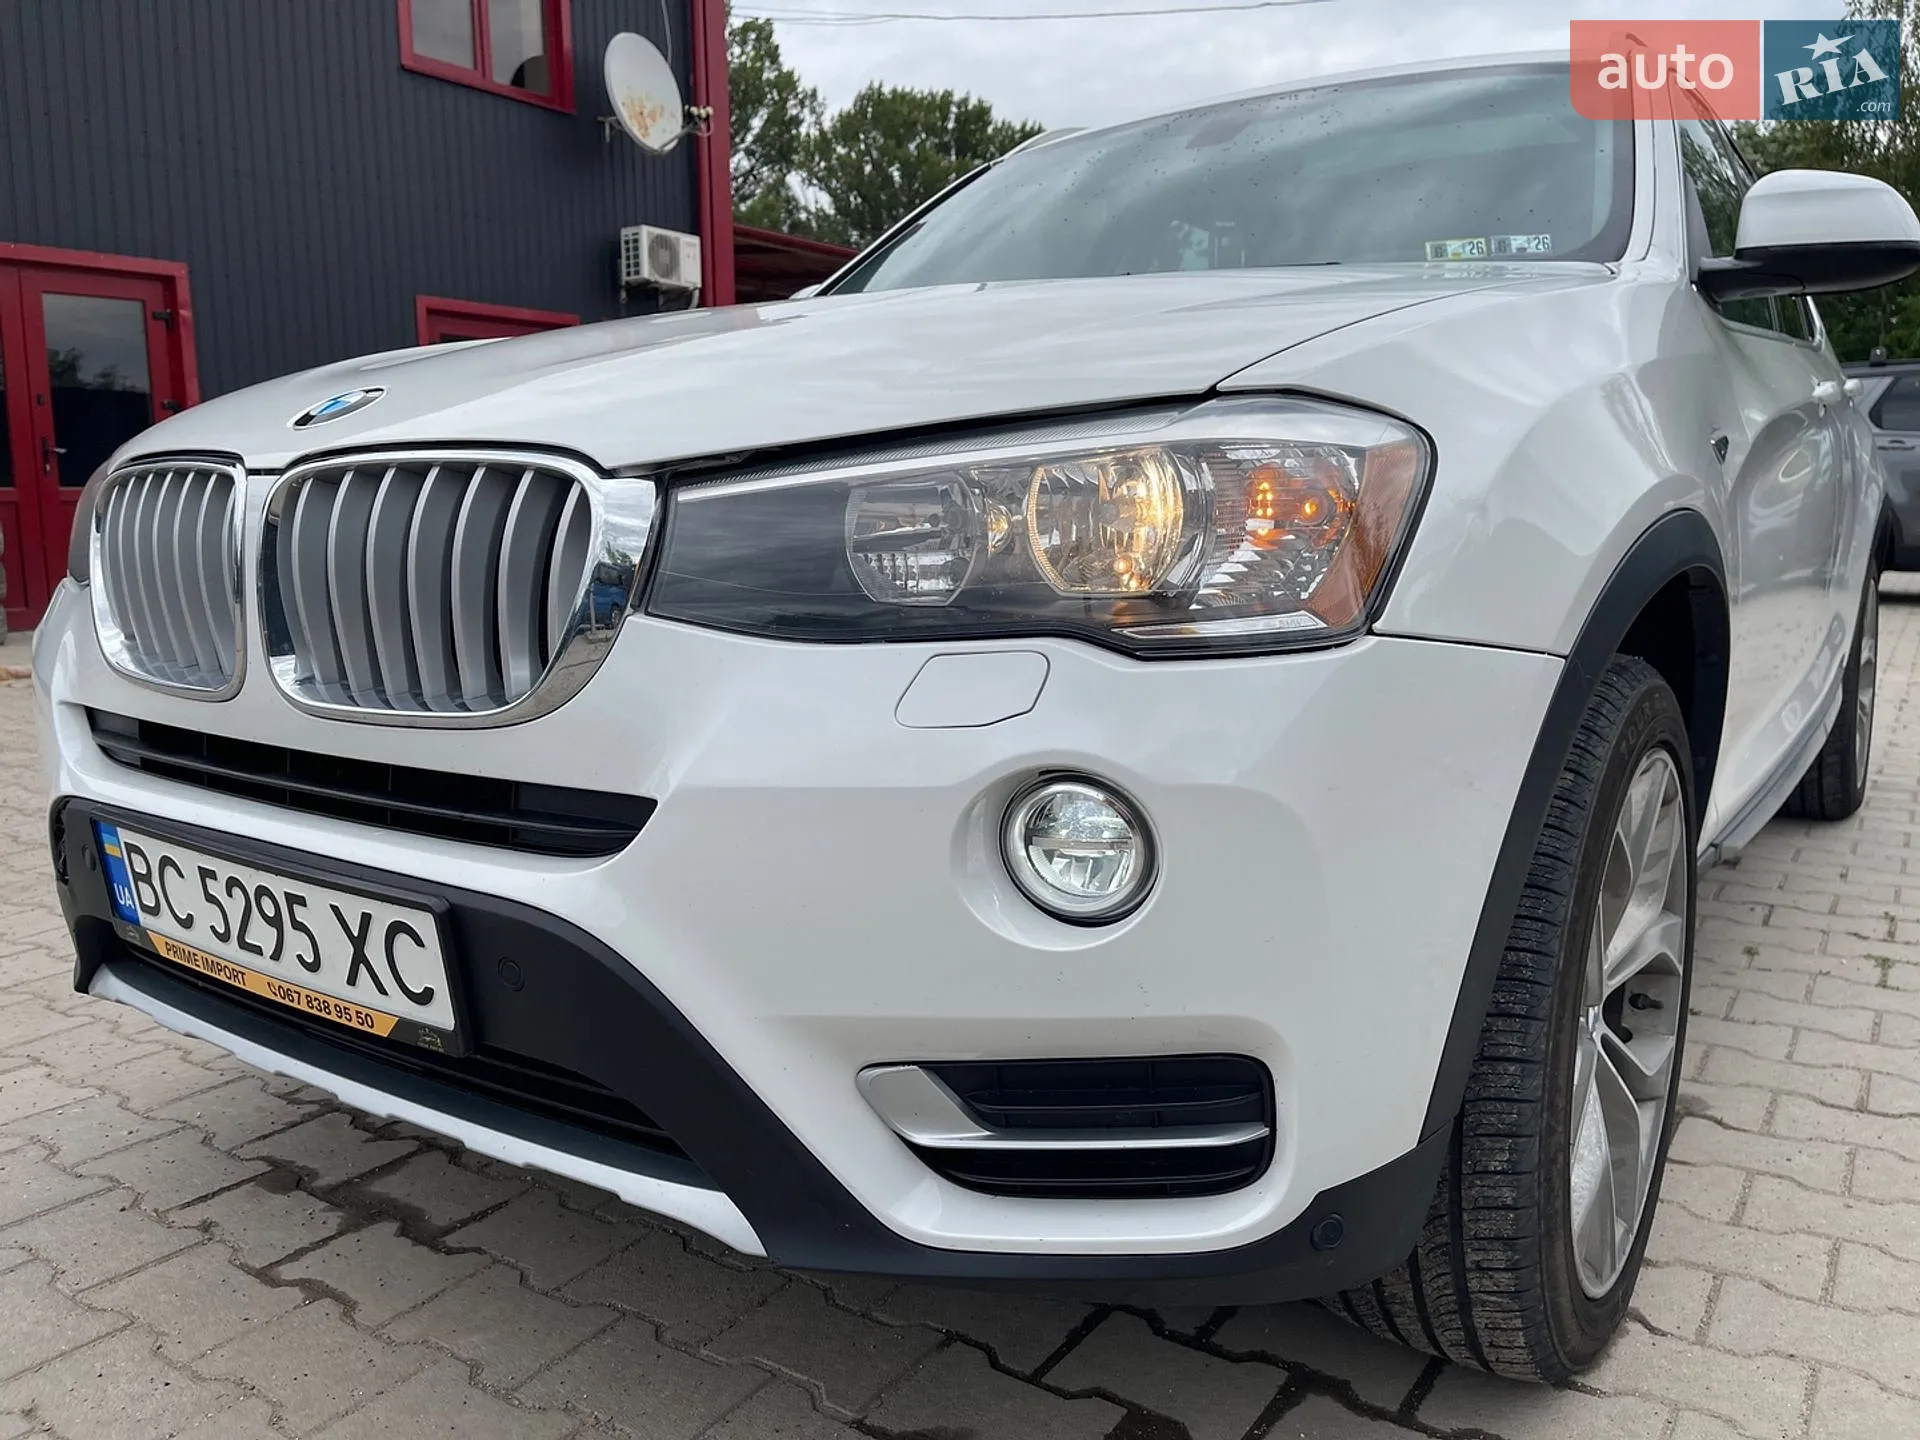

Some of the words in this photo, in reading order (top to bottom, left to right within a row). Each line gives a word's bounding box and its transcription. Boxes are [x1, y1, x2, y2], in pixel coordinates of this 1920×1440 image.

[1467, 241, 1485, 256] 26
[1534, 235, 1550, 251] 26
[115, 882, 135, 910] UA
[123, 840, 195, 930] BC
[197, 865, 322, 974] 5295
[328, 902, 436, 1006] XC
[165, 941, 200, 968] PRIME
[200, 955, 247, 986] IMPORT
[278, 984, 301, 1005] 067
[306, 994, 332, 1016] 838
[335, 1003, 352, 1023] 95
[356, 1009, 375, 1030] 50
